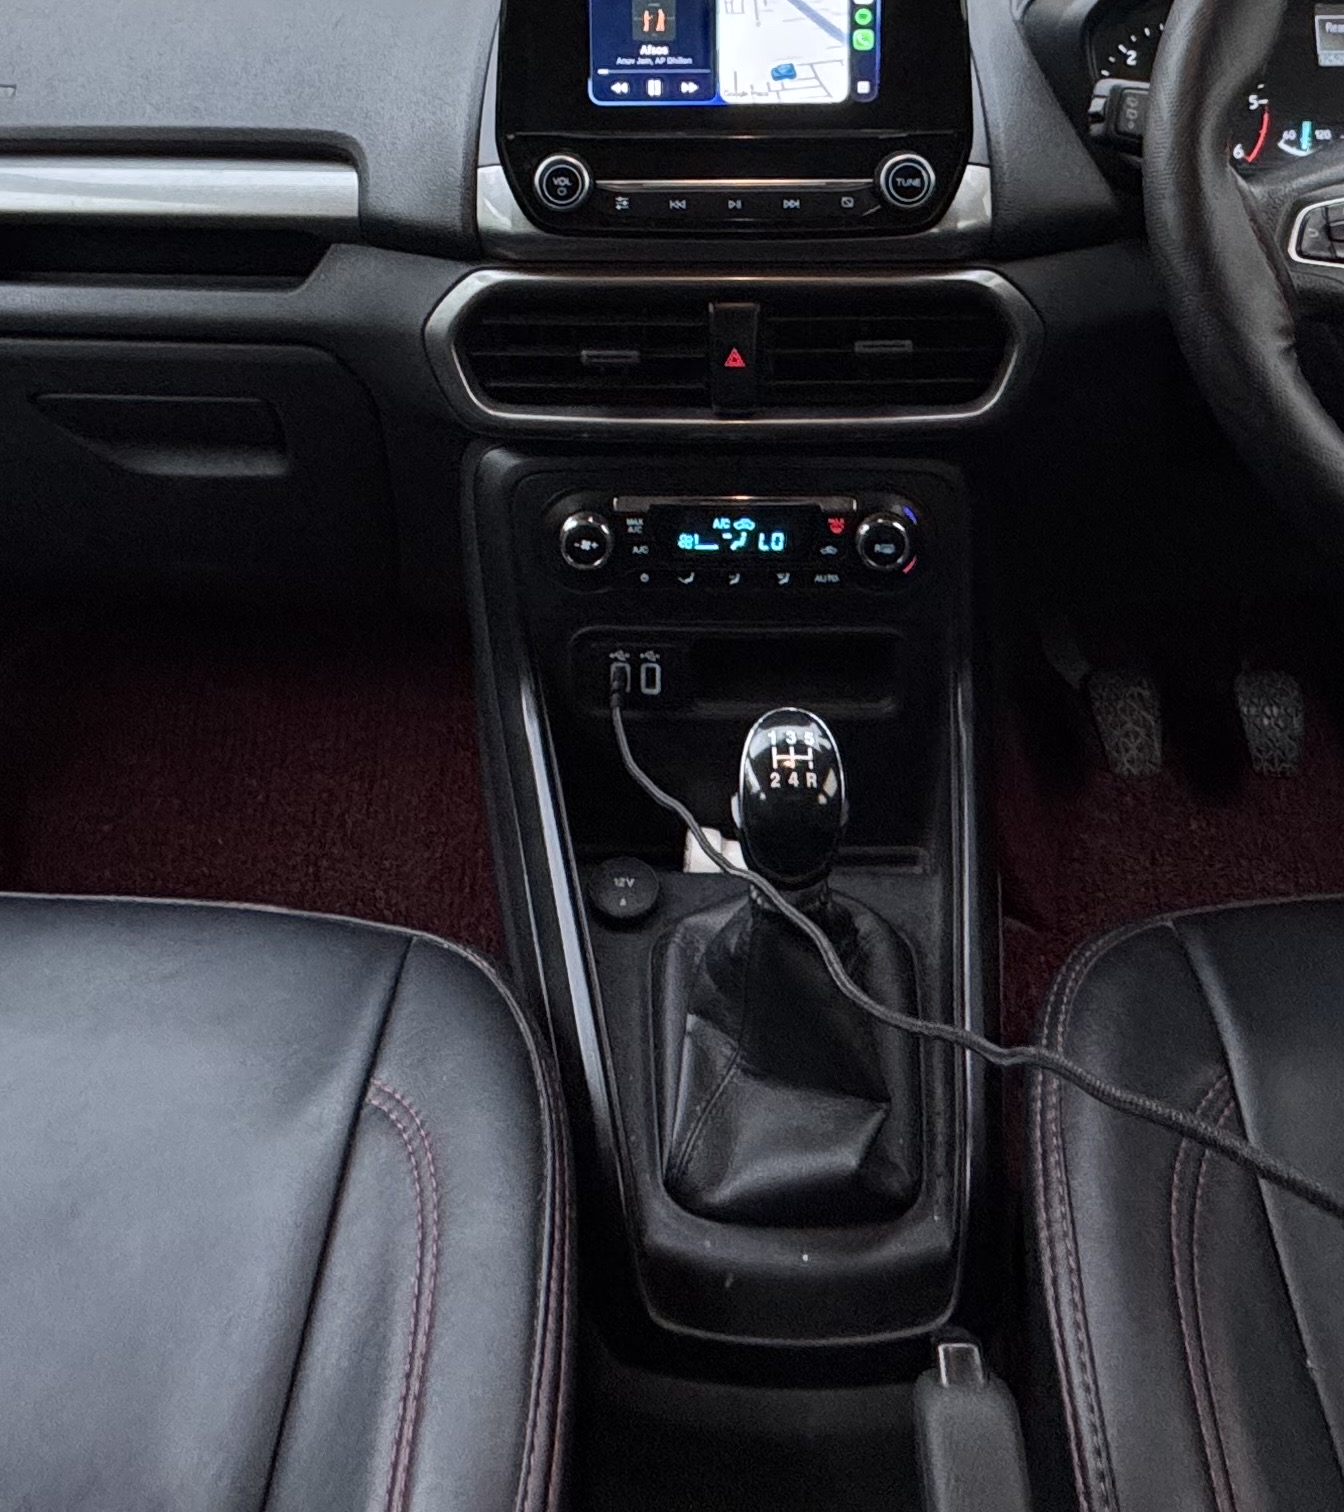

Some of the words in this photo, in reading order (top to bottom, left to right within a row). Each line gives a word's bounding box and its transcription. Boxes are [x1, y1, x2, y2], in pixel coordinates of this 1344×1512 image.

[639, 44, 669, 56] Afsos
[1126, 50, 1137, 66] 2
[1249, 94, 1259, 110] 5
[1283, 129, 1296, 140] 60
[1314, 129, 1332, 140] 120
[1233, 143, 1244, 159] 6
[552, 176, 572, 187] VOL
[896, 177, 922, 188] TUNE
[626, 518, 644, 526] MAX
[712, 518, 731, 530] A/C
[758, 532, 785, 551] LO
[814, 573, 840, 584] AUTO
[767, 730, 777, 746] 1
[785, 730, 797, 745] 3
[804, 731, 815, 746] 5
[769, 771, 781, 788] 2
[788, 771, 799, 788] 4
[805, 771, 818, 788] R
[614, 876, 635, 888] 12V
